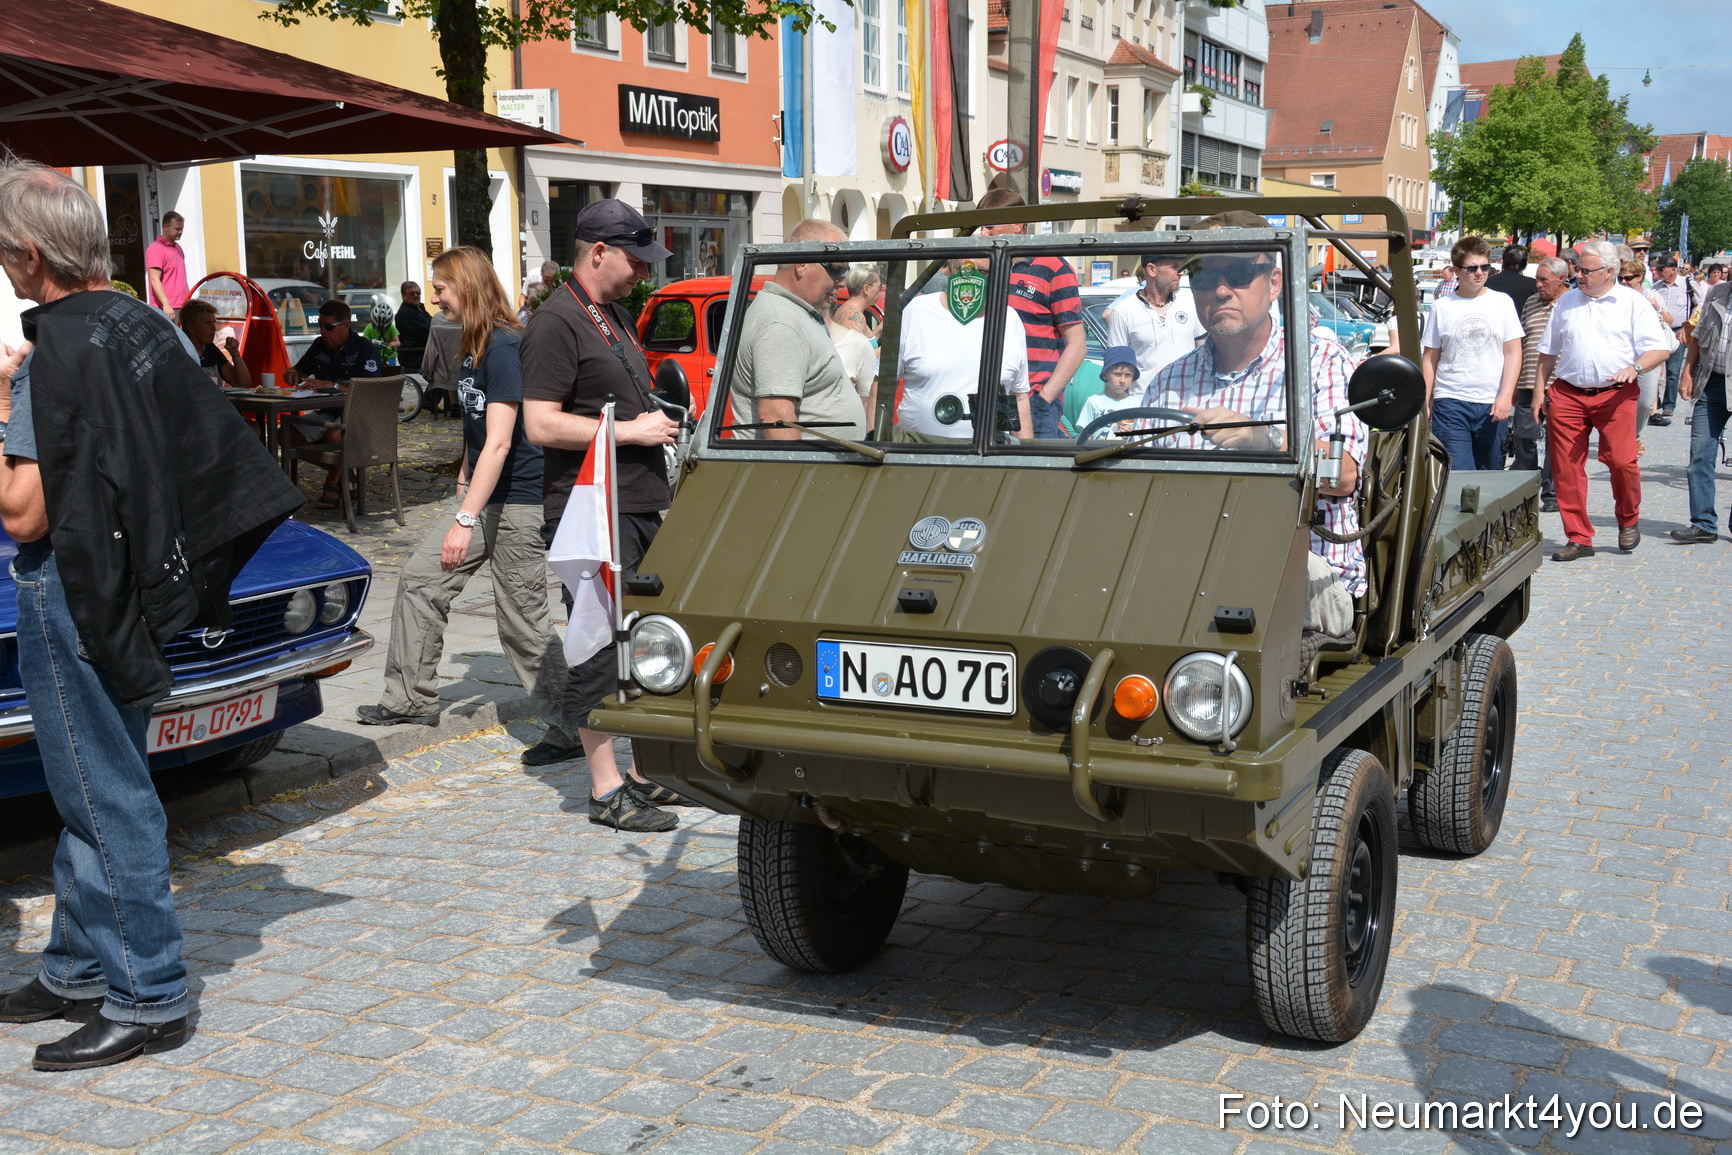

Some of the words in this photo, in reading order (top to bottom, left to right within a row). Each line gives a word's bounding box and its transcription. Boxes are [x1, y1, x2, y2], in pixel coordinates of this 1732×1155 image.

[500, 103, 526, 111] WALTER
[894, 131, 910, 158] C&A
[993, 148, 1020, 163] C&A
[303, 240, 328, 268] Café
[1027, 285, 1036, 295] 50
[587, 304, 603, 323] EOS
[599, 322, 611, 336] 50D
[952, 522, 982, 531] PUCH
[900, 552, 974, 566] HAFLINGER
[825, 675, 834, 688] D
[843, 651, 867, 693] N
[894, 655, 947, 700] AO
[958, 660, 1009, 705] 70
[157, 713, 195, 747] RH
[209, 694, 263, 735] 0791
